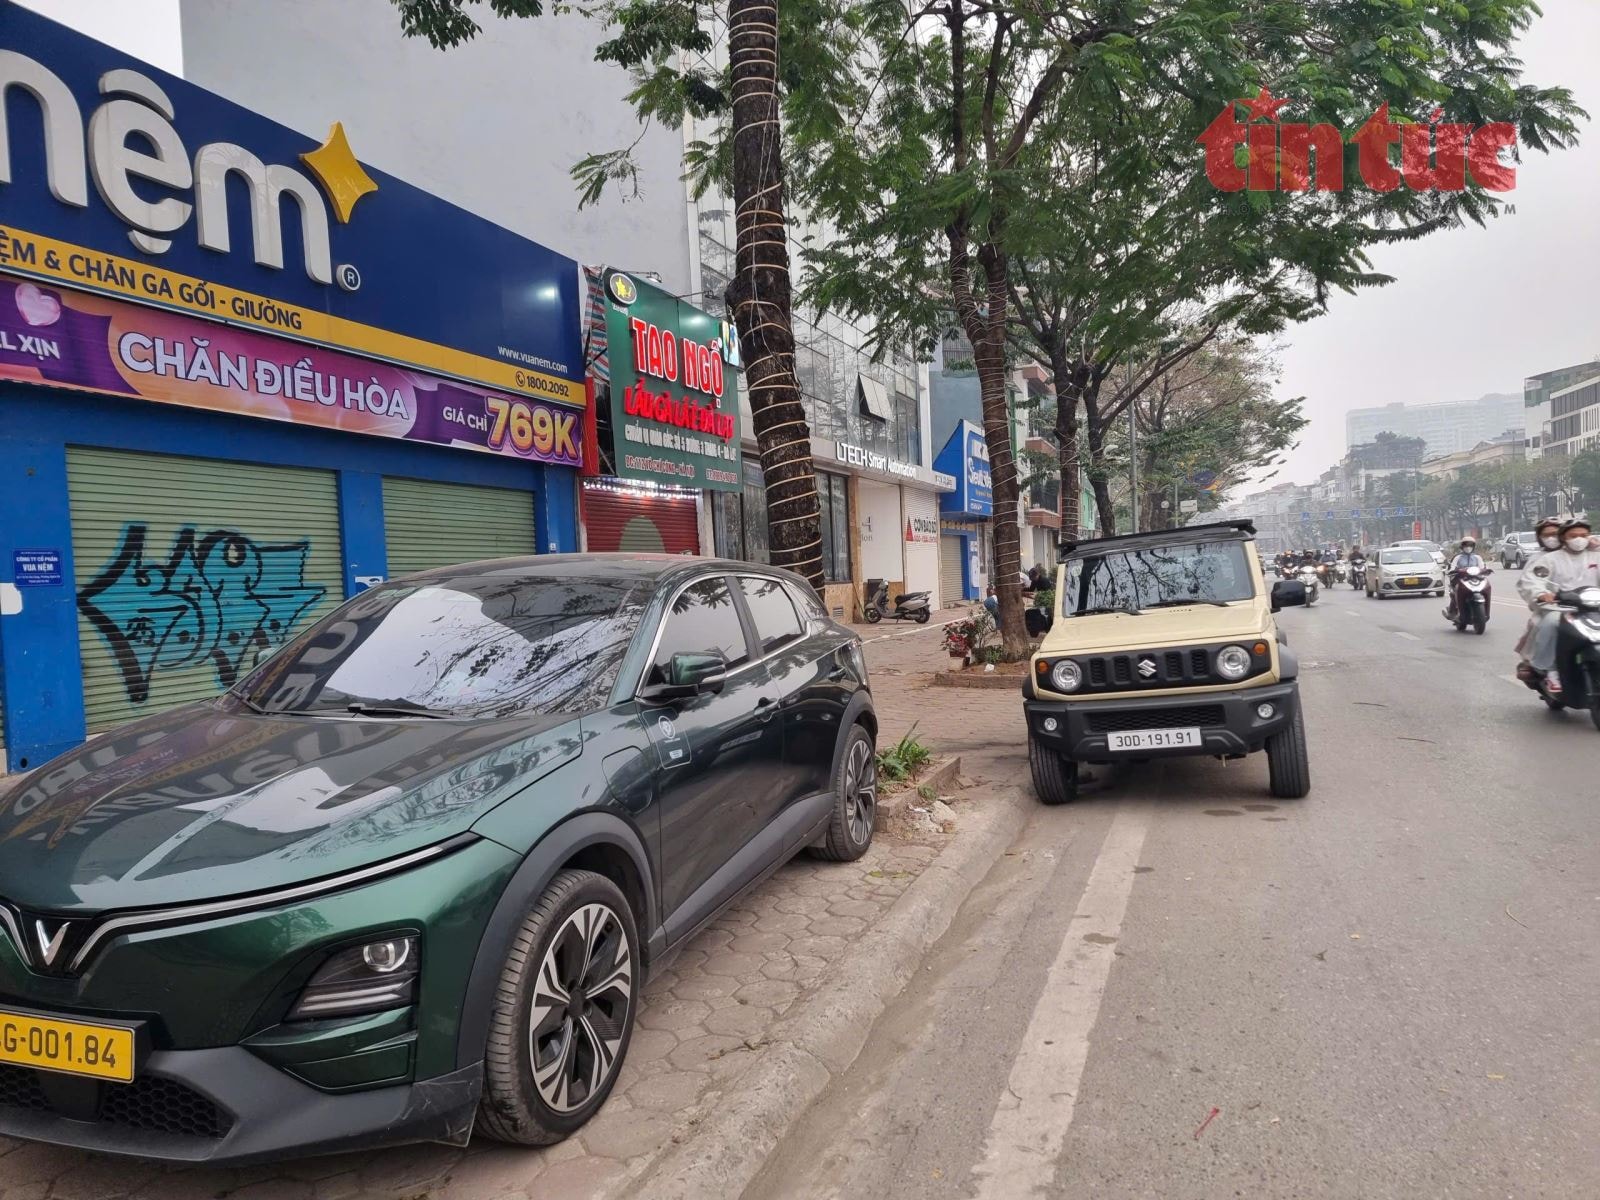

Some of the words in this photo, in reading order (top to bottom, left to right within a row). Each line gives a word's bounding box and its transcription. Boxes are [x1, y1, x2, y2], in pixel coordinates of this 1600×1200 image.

[0, 50, 333, 284] nệm
[0, 230, 36, 265] ỆM
[44, 250, 61, 270] &
[69, 258, 136, 290] CHĂN
[142, 273, 173, 299] GA
[179, 281, 216, 309] GỐI
[231, 299, 302, 330] GIƯỜNG
[17, 333, 60, 361] XỊN
[497, 345, 568, 374] www.vuanem.com
[631, 317, 678, 382] TAO
[683, 337, 724, 408] NGỘ
[118, 331, 249, 391] CHĂN
[253, 357, 337, 407] ĐIỀU
[343, 376, 410, 420] HÒA
[526, 375, 569, 397] 1800.2092
[443, 407, 466, 425] GIÁ
[467, 413, 488, 432] CHỈ
[486, 396, 578, 459] 769K
[868, 450, 887, 471] Smart
[23, 563, 37, 572] VUA
[1116, 732, 1192, 748] 30D-191.91
[0, 1022, 116, 1069] G-001.84
